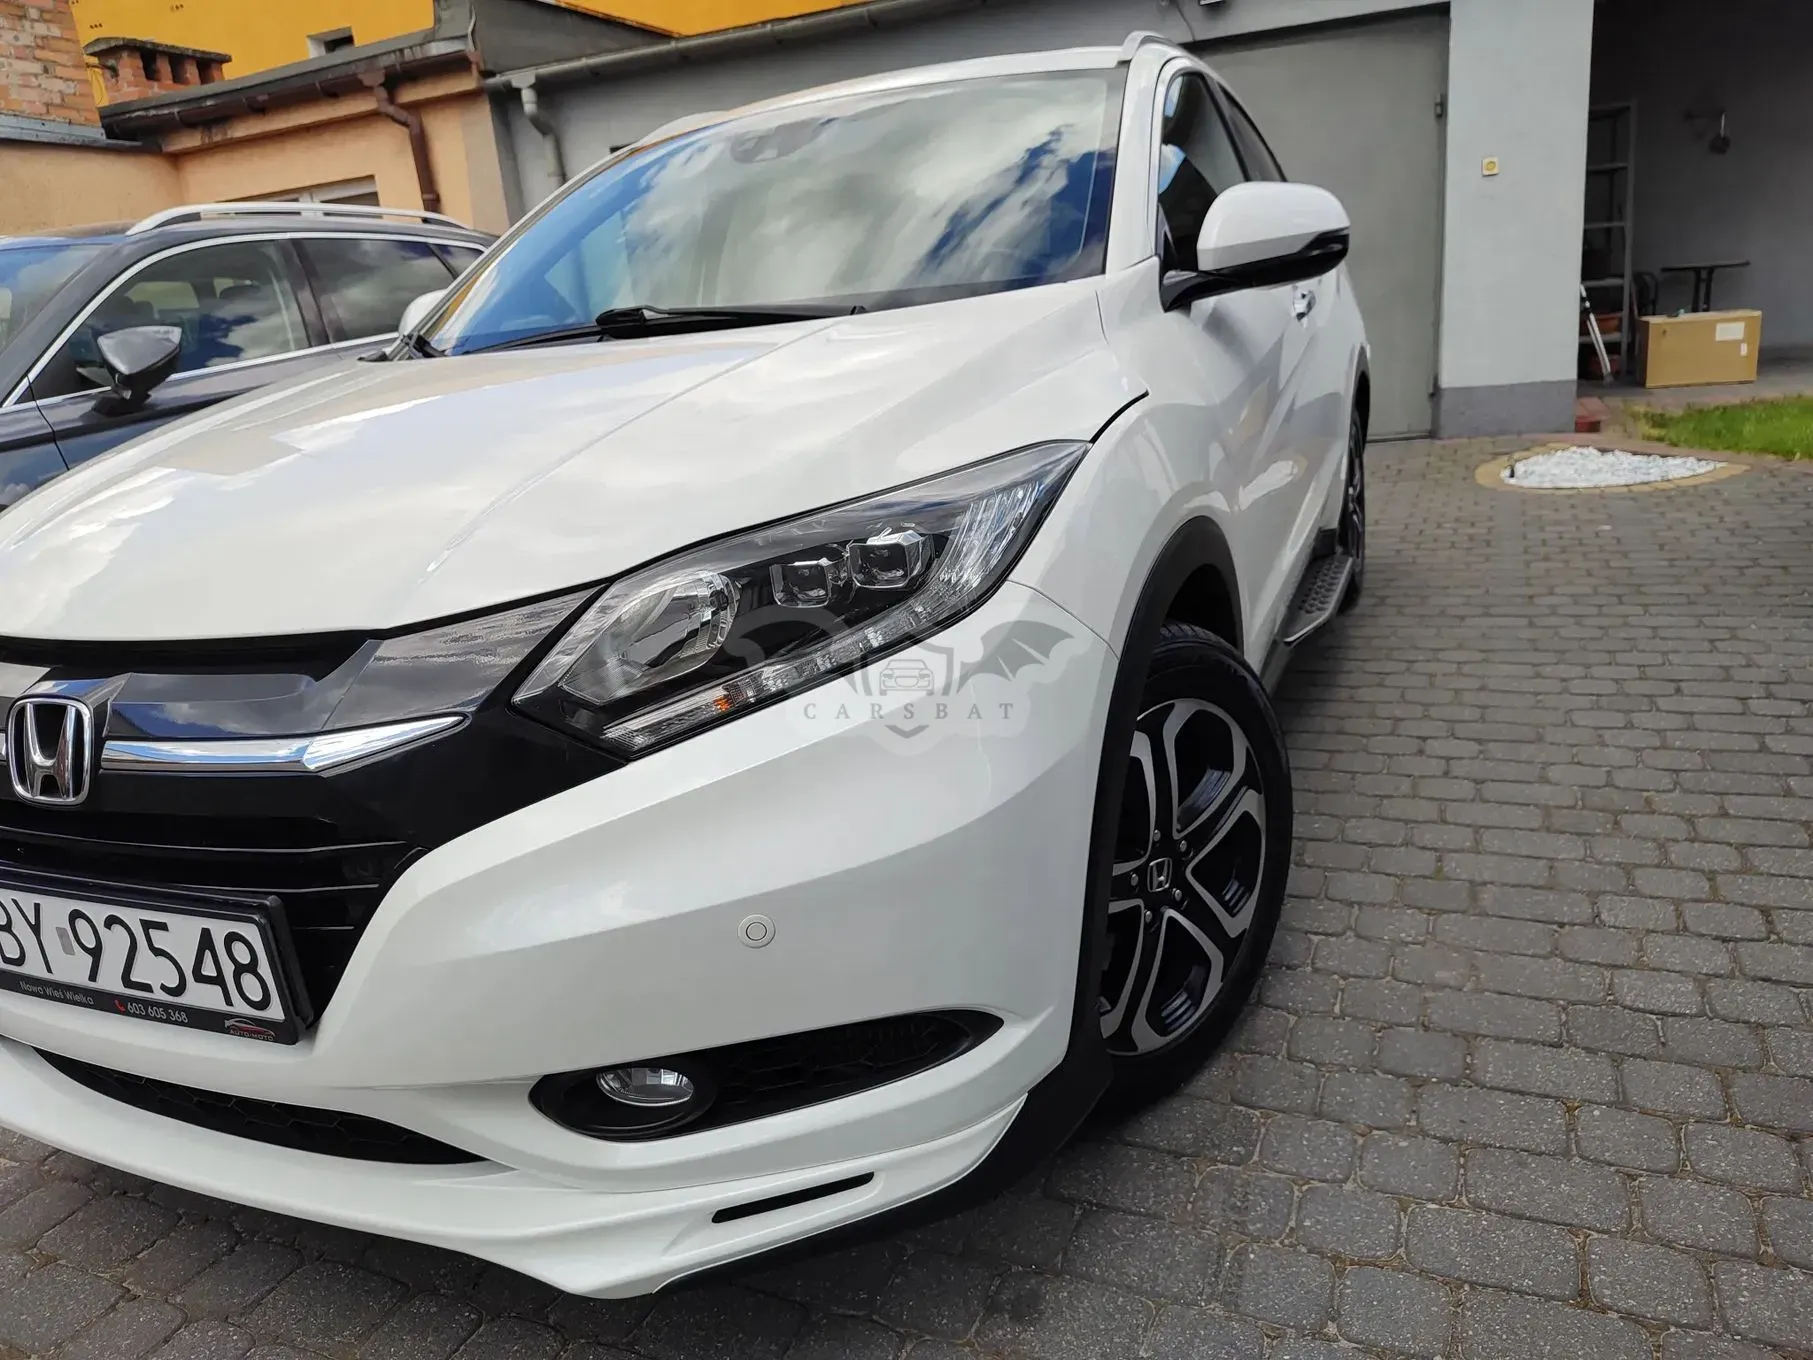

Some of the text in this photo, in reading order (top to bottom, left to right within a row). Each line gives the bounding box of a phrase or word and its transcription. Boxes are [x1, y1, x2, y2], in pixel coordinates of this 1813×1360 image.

[68, 908, 272, 1011] 92548
[19, 981, 44, 994] Nowa
[64, 990, 94, 1005] Wielka
[127, 1002, 189, 1023] 603 605 368
